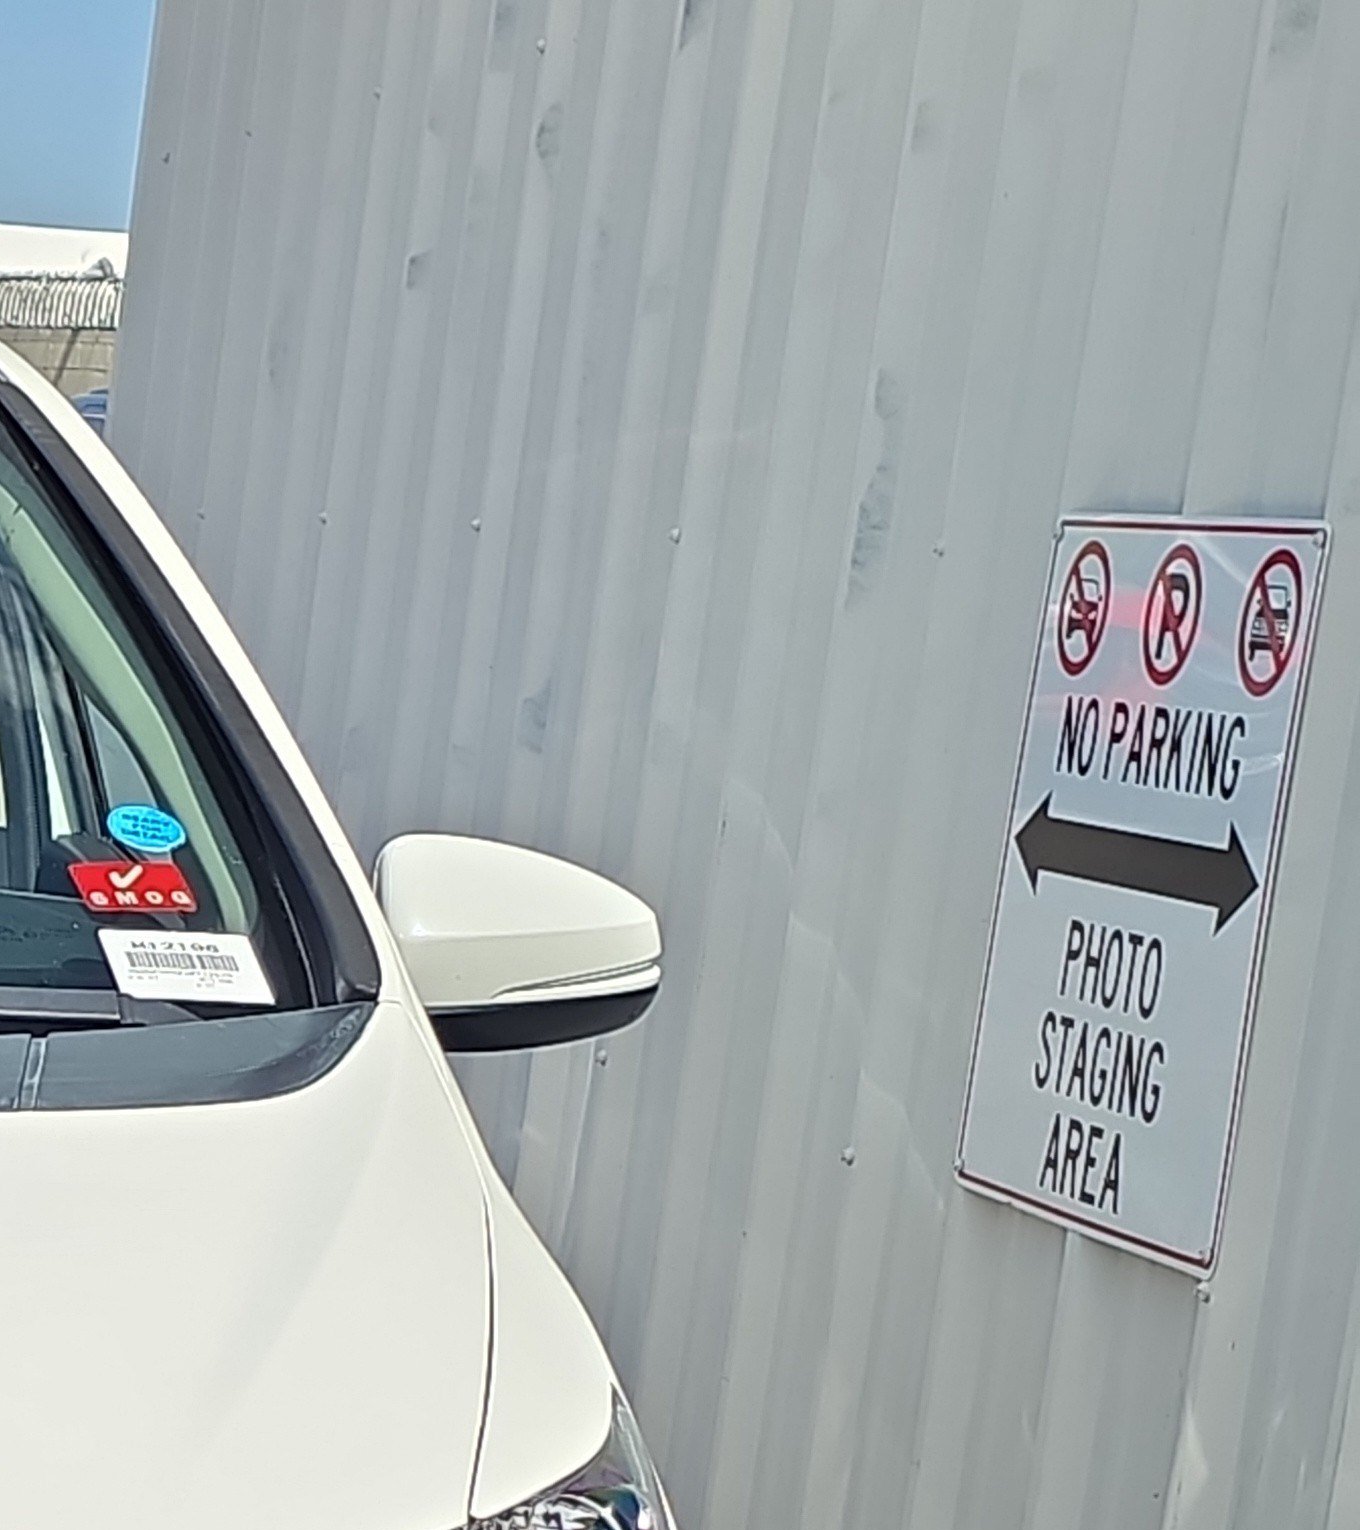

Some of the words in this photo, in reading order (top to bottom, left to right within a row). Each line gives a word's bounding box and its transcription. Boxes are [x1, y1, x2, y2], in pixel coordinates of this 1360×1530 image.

[1056, 696, 1100, 776] NO
[1103, 701, 1245, 800] PARKING
[1060, 919, 1163, 1020] PHOTO
[1034, 1011, 1165, 1123] STAGING
[1039, 1113, 1122, 1216] AREA
